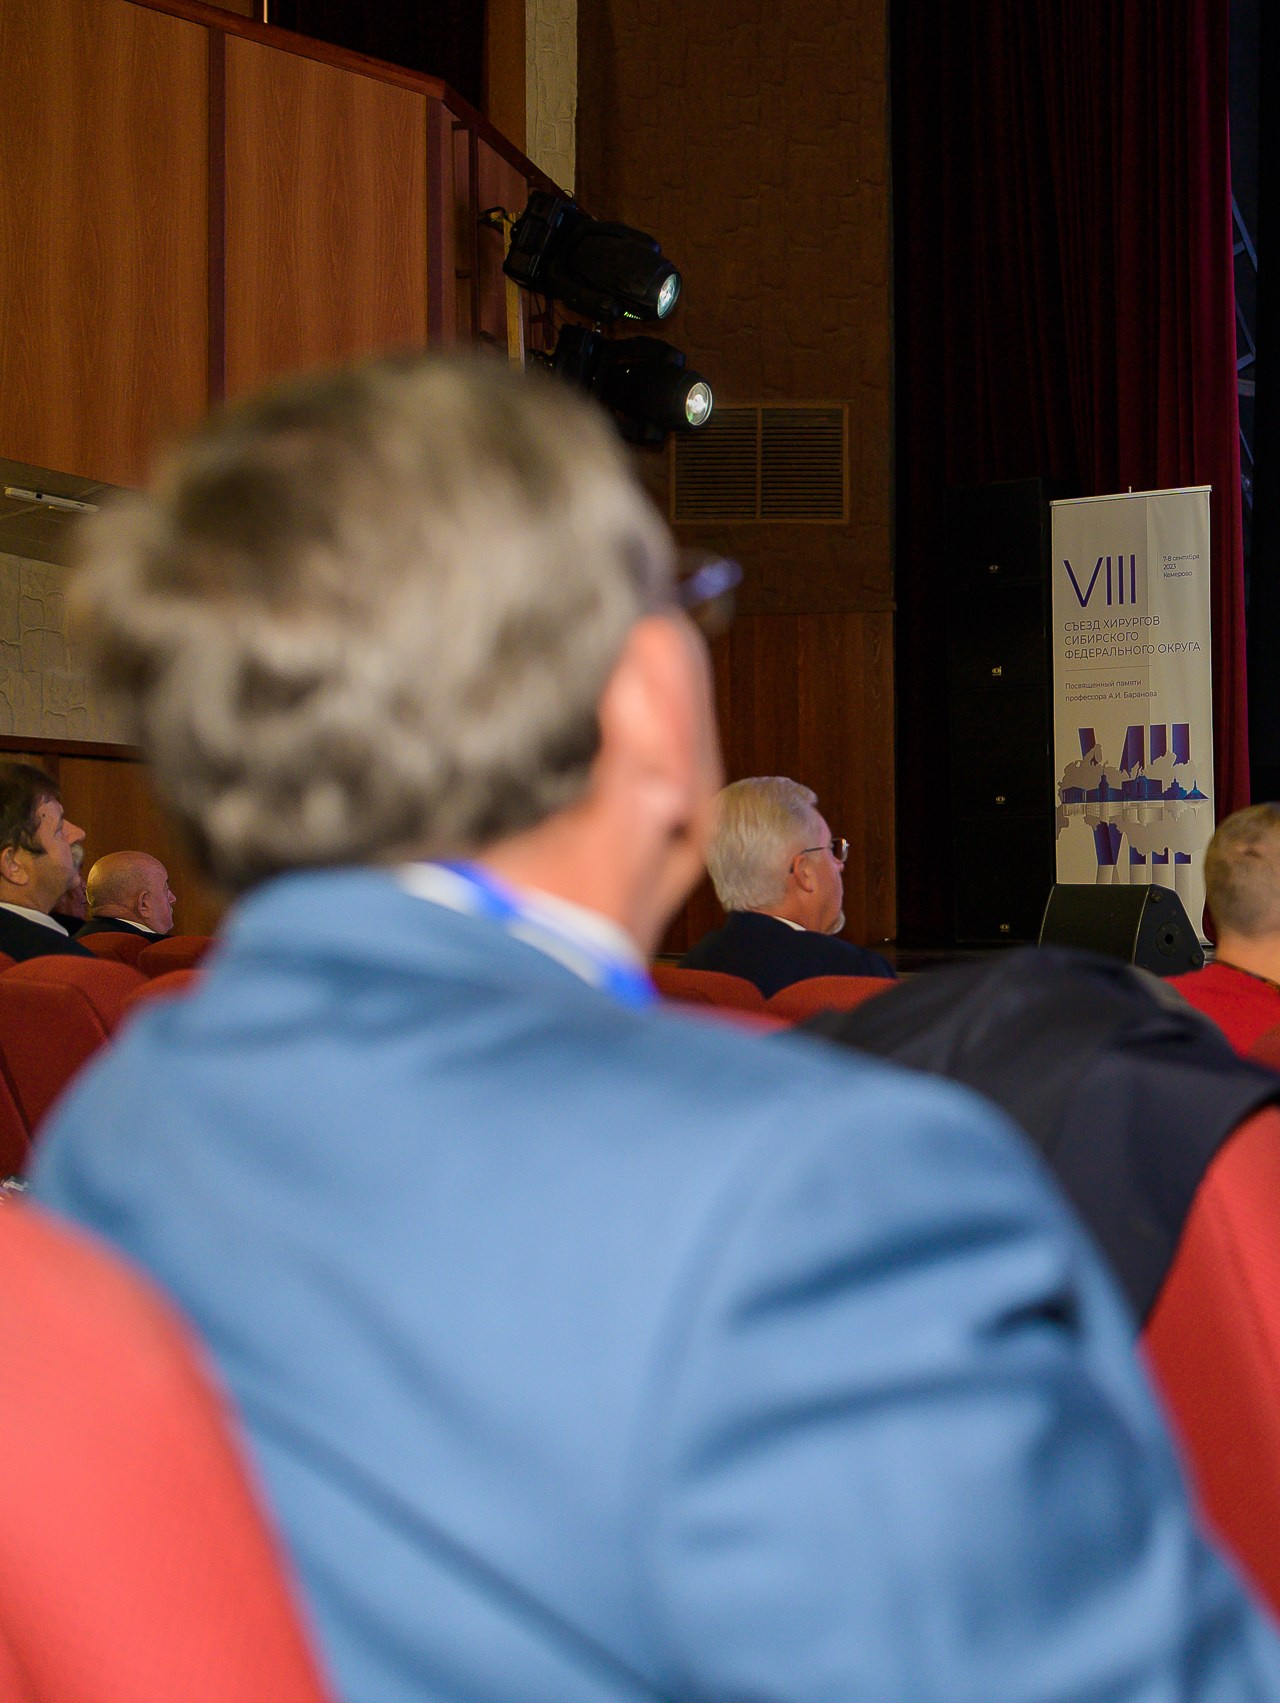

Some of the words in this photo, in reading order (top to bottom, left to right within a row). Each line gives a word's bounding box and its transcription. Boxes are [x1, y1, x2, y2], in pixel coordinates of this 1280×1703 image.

[1063, 554, 1136, 607] VIII
[1064, 620, 1101, 632] СЪЕЗД
[1103, 616, 1161, 629] ХИРУРГОВ
[1064, 632, 1139, 645] СИБИРСКОГО
[1064, 644, 1155, 660] ФЕДЕРАЛЬНОГО
[1157, 641, 1201, 654] ОКРУГА
[1116, 679, 1142, 687] памяти
[1065, 694, 1107, 702] профессора
[1123, 691, 1158, 699] Баранова
